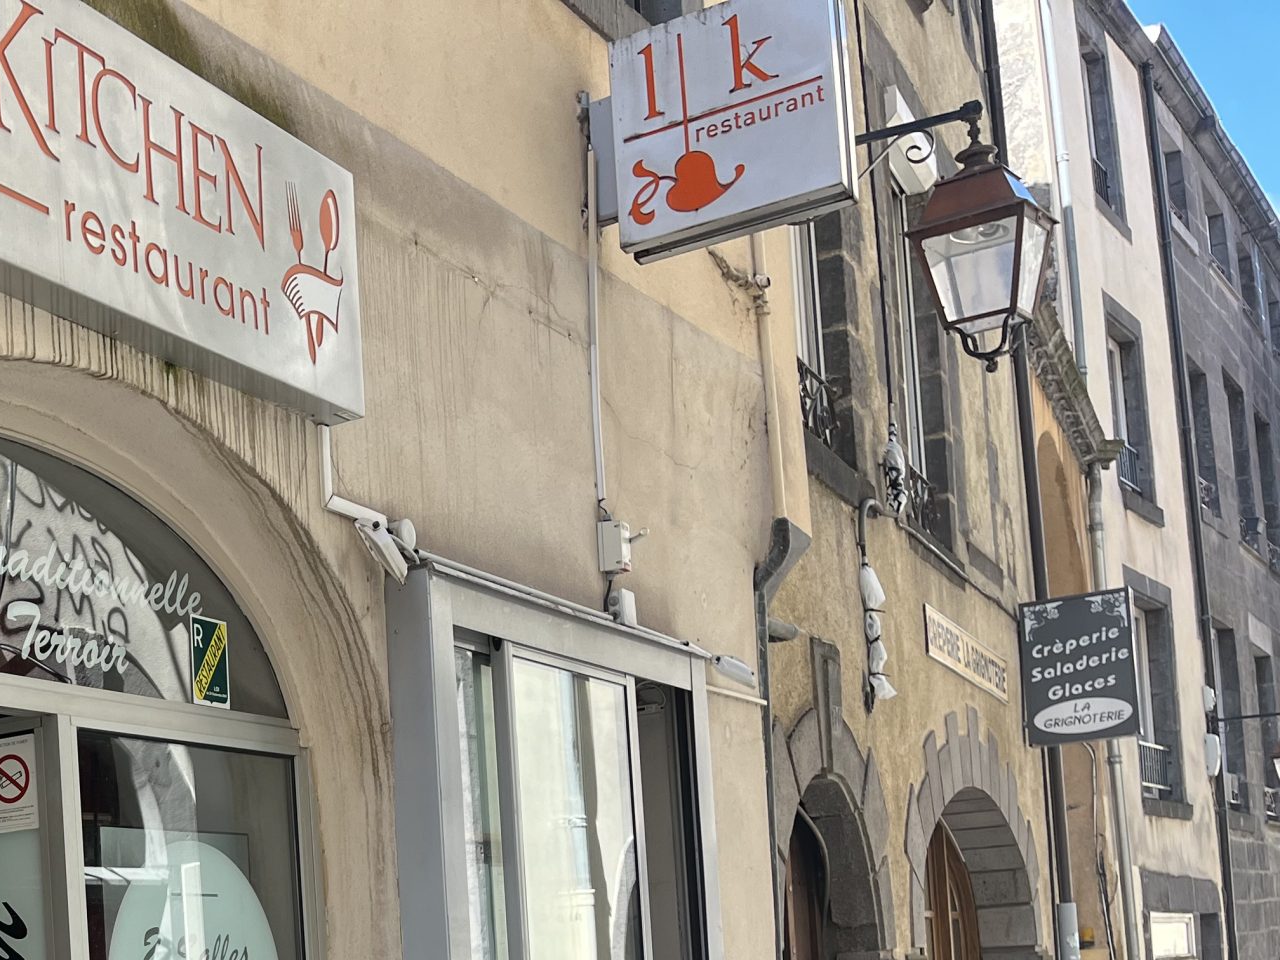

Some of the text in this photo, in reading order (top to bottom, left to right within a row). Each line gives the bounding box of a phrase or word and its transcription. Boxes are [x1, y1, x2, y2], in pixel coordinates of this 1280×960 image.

[695, 84, 825, 143] restaurant
[64, 199, 271, 335] restaurant
[7, 601, 129, 673] Terroir
[193, 623, 203, 648] R
[196, 627, 226, 697] RESTAURANT
[1031, 647, 1130, 682] Saladerie
[1048, 675, 1116, 700] Glaces
[1044, 709, 1125, 729] GRIGNOTERIE
[1073, 703, 1091, 714] LA
